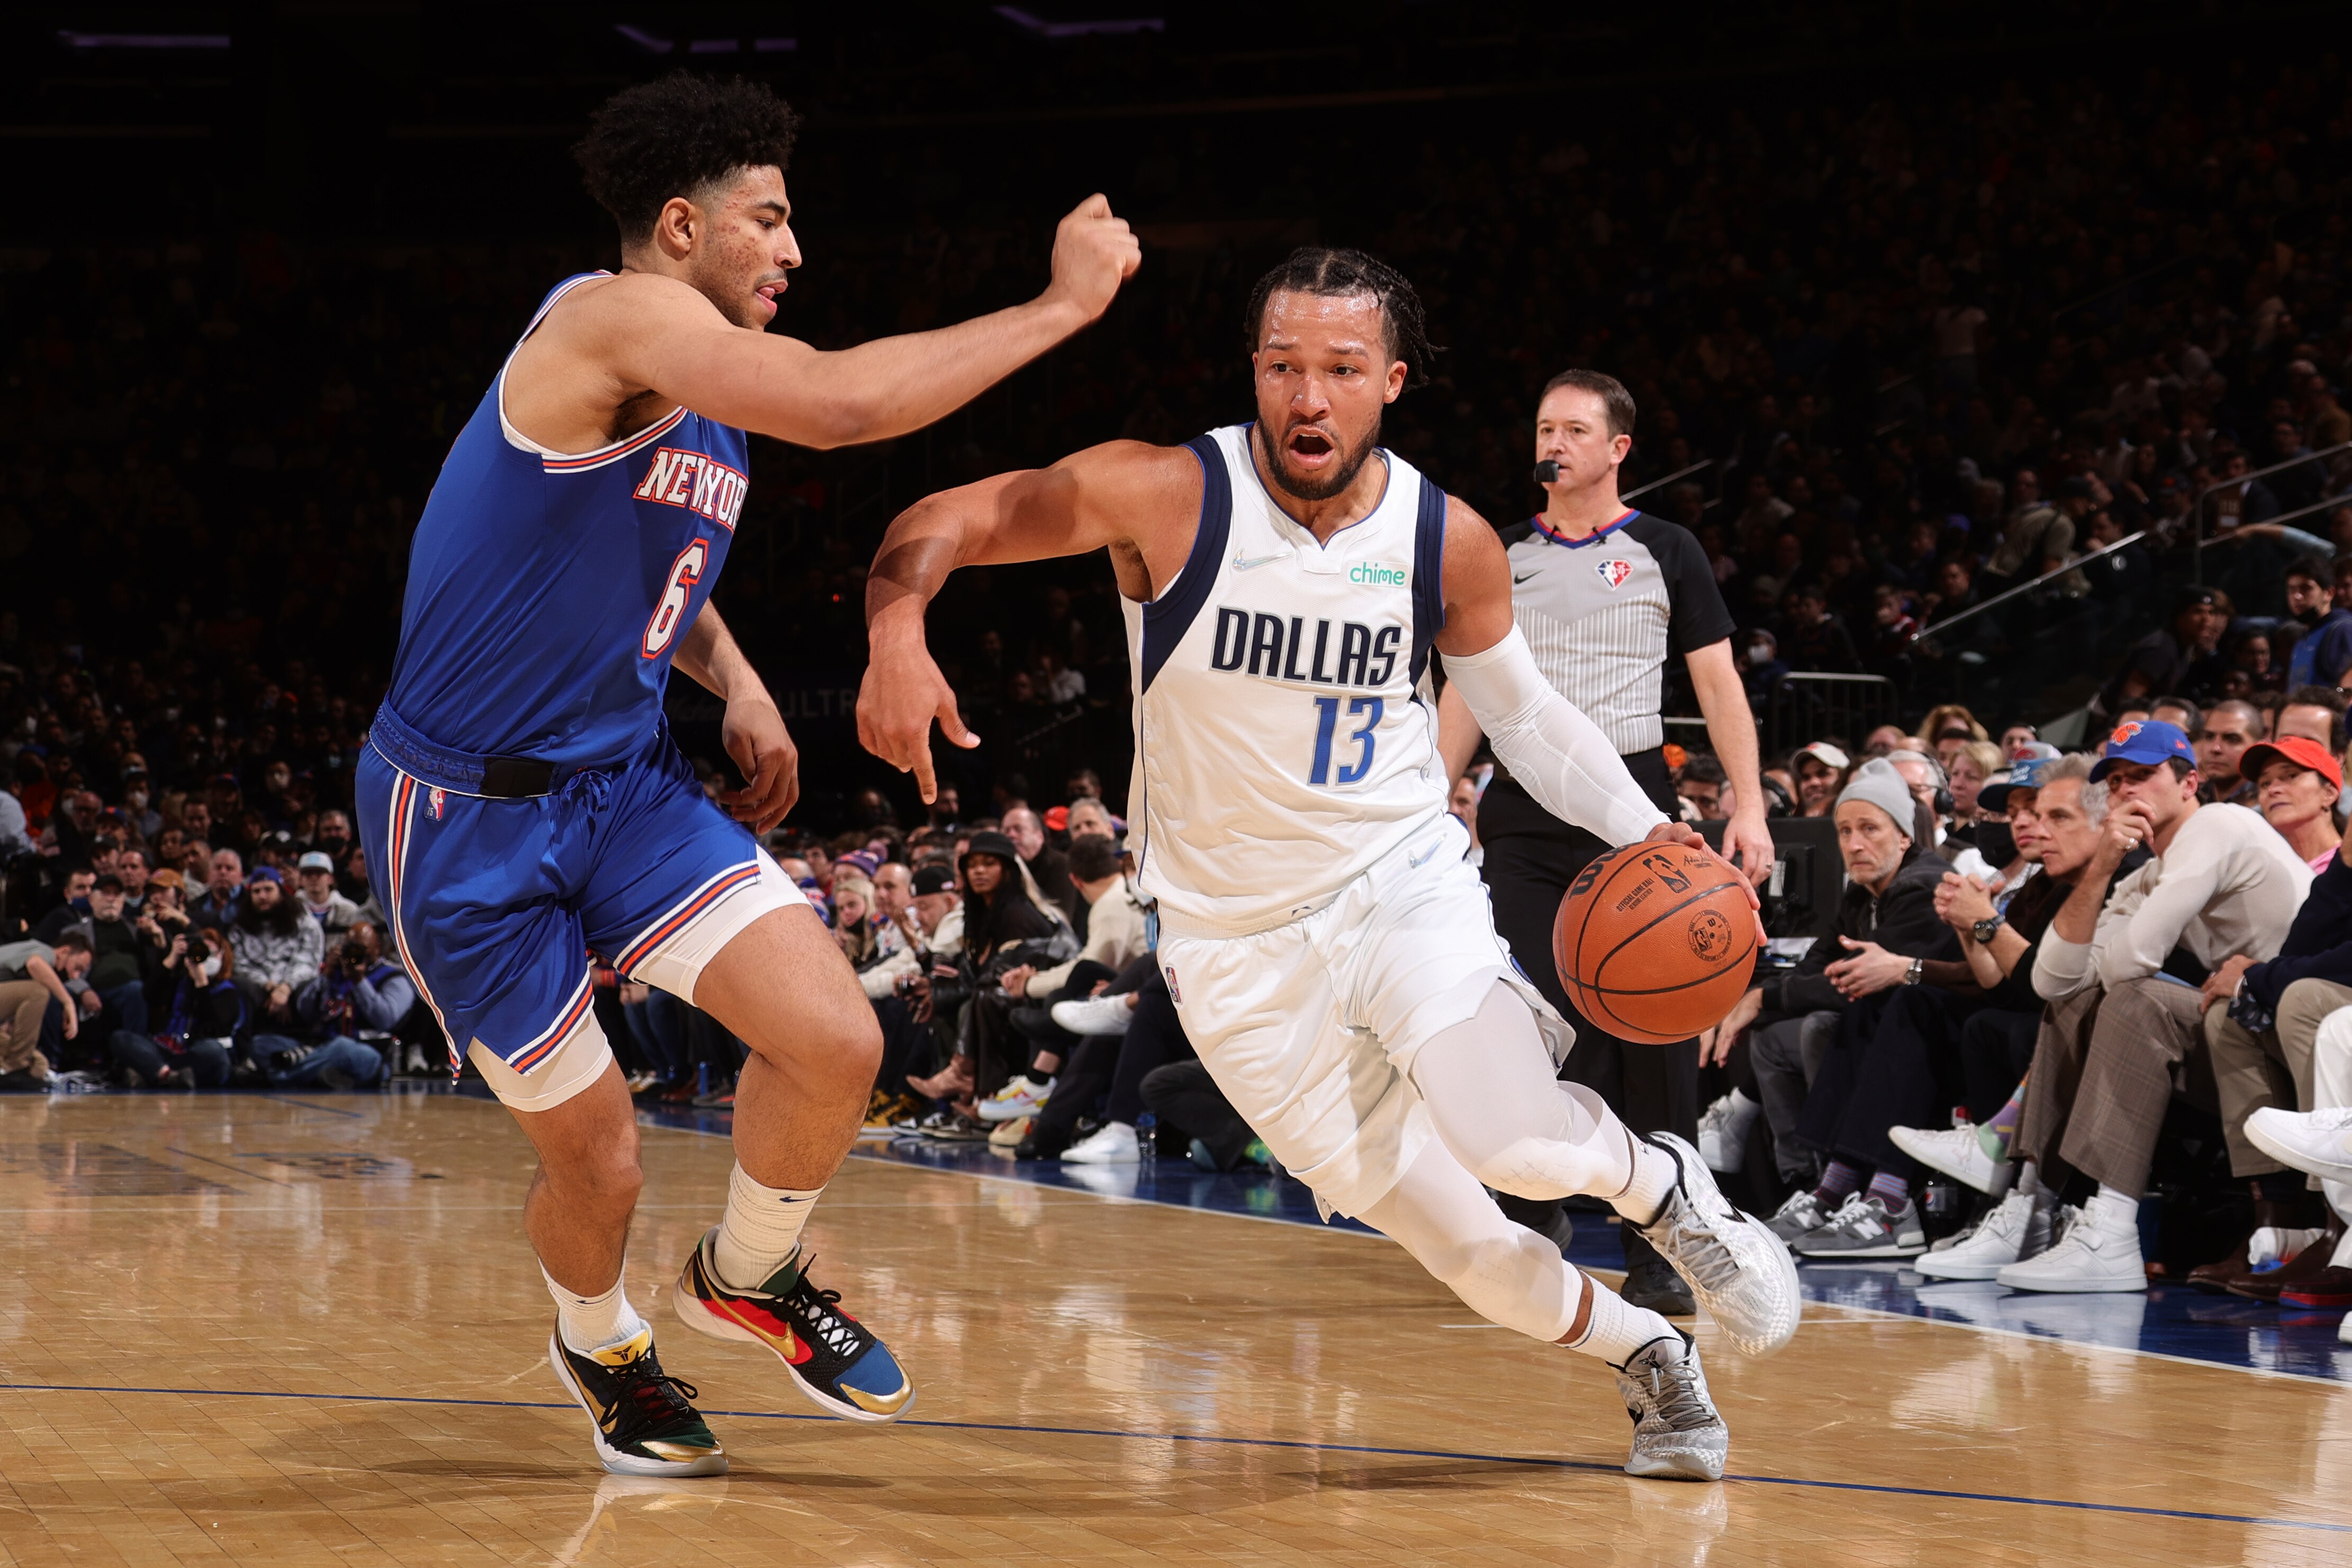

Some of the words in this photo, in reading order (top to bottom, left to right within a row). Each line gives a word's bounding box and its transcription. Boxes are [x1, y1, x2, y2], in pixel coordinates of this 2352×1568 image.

[700, 460, 749, 534] YOR
[642, 538, 709, 659] 6
[1350, 562, 1406, 586] chime
[1209, 605, 1403, 688] DALLAS
[776, 688, 857, 719] ULTR
[1307, 695, 1385, 786] 13
[1616, 893, 1635, 911] OFFICIAL
[1642, 878, 1655, 887] BALL
